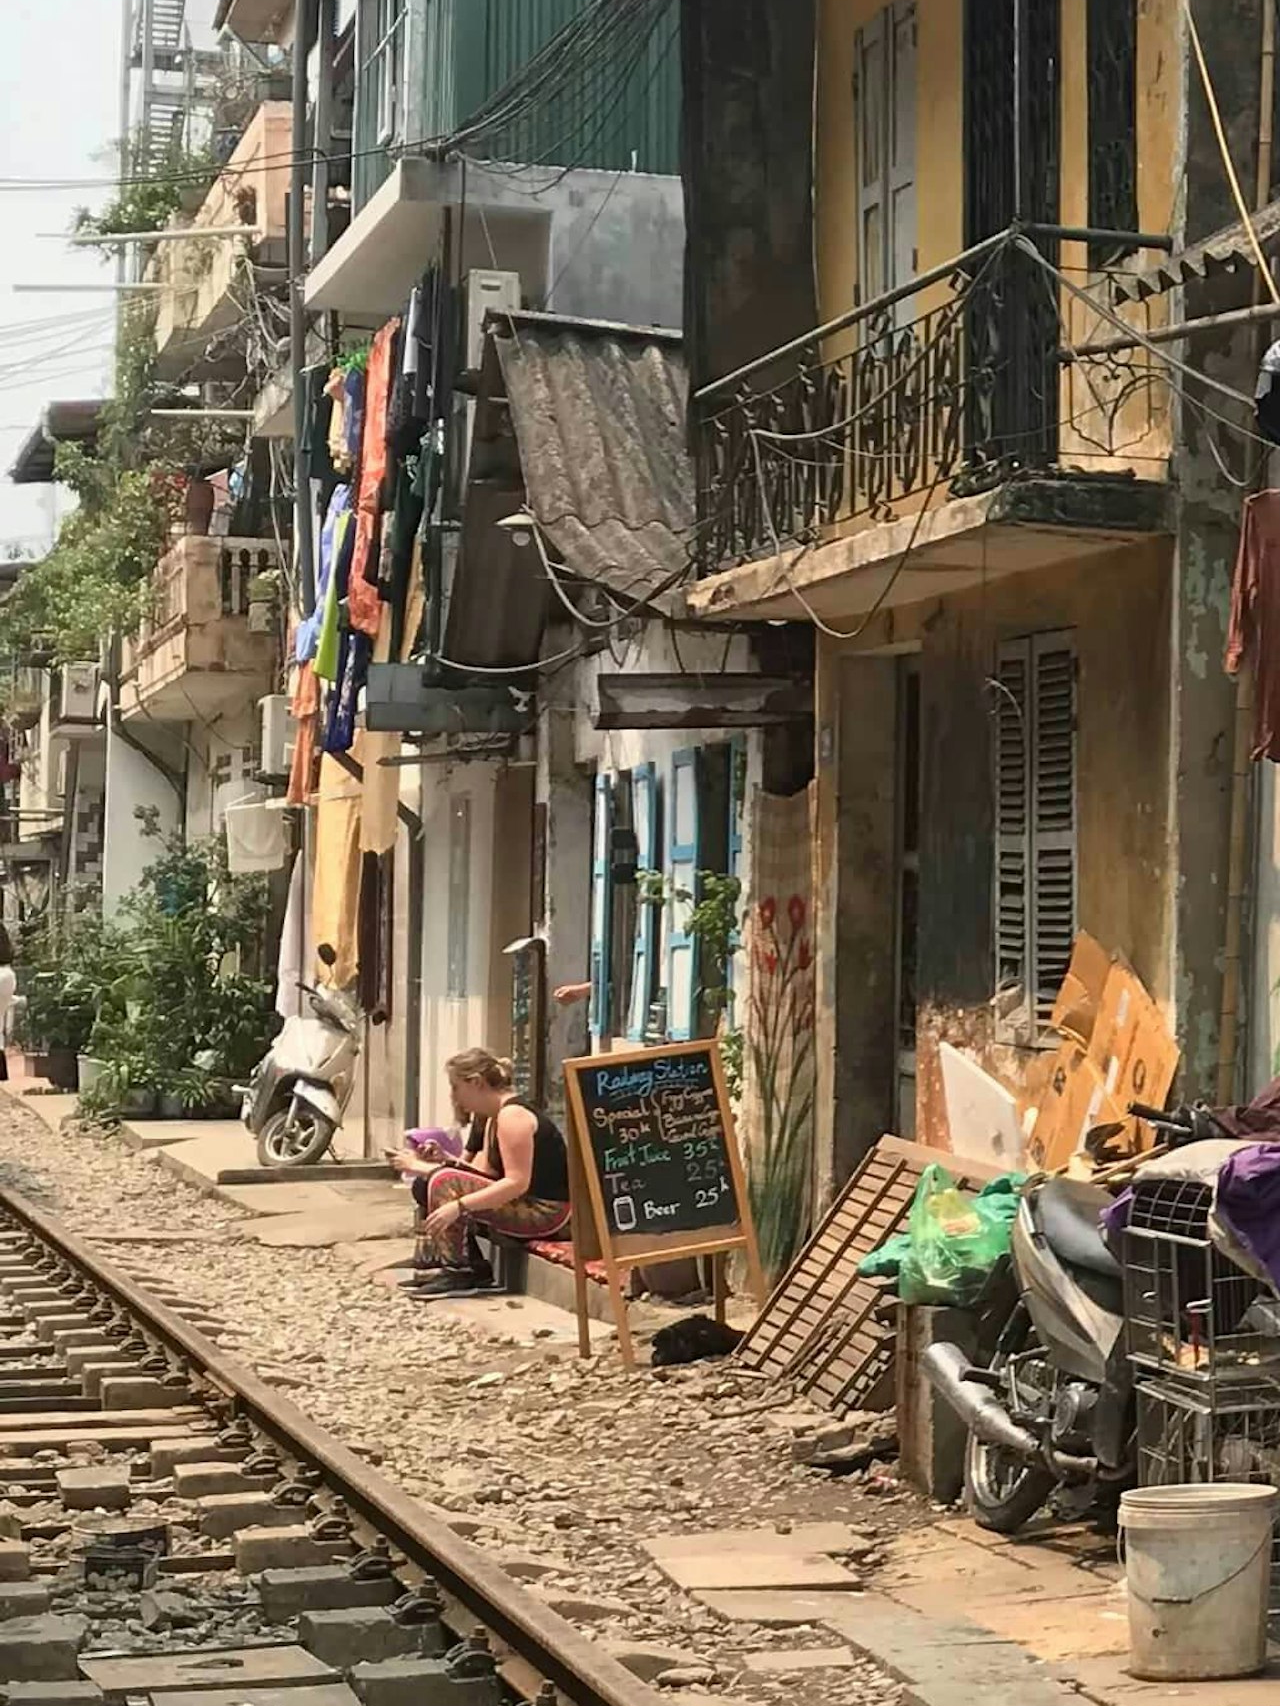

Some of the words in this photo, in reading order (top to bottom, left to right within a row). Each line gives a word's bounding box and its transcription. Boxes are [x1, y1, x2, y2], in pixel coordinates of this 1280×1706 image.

[592, 1097, 650, 1135] Special
[604, 1171, 647, 1194] Tea
[643, 1199, 682, 1220] Beer
[694, 1175, 730, 1209] 25k
